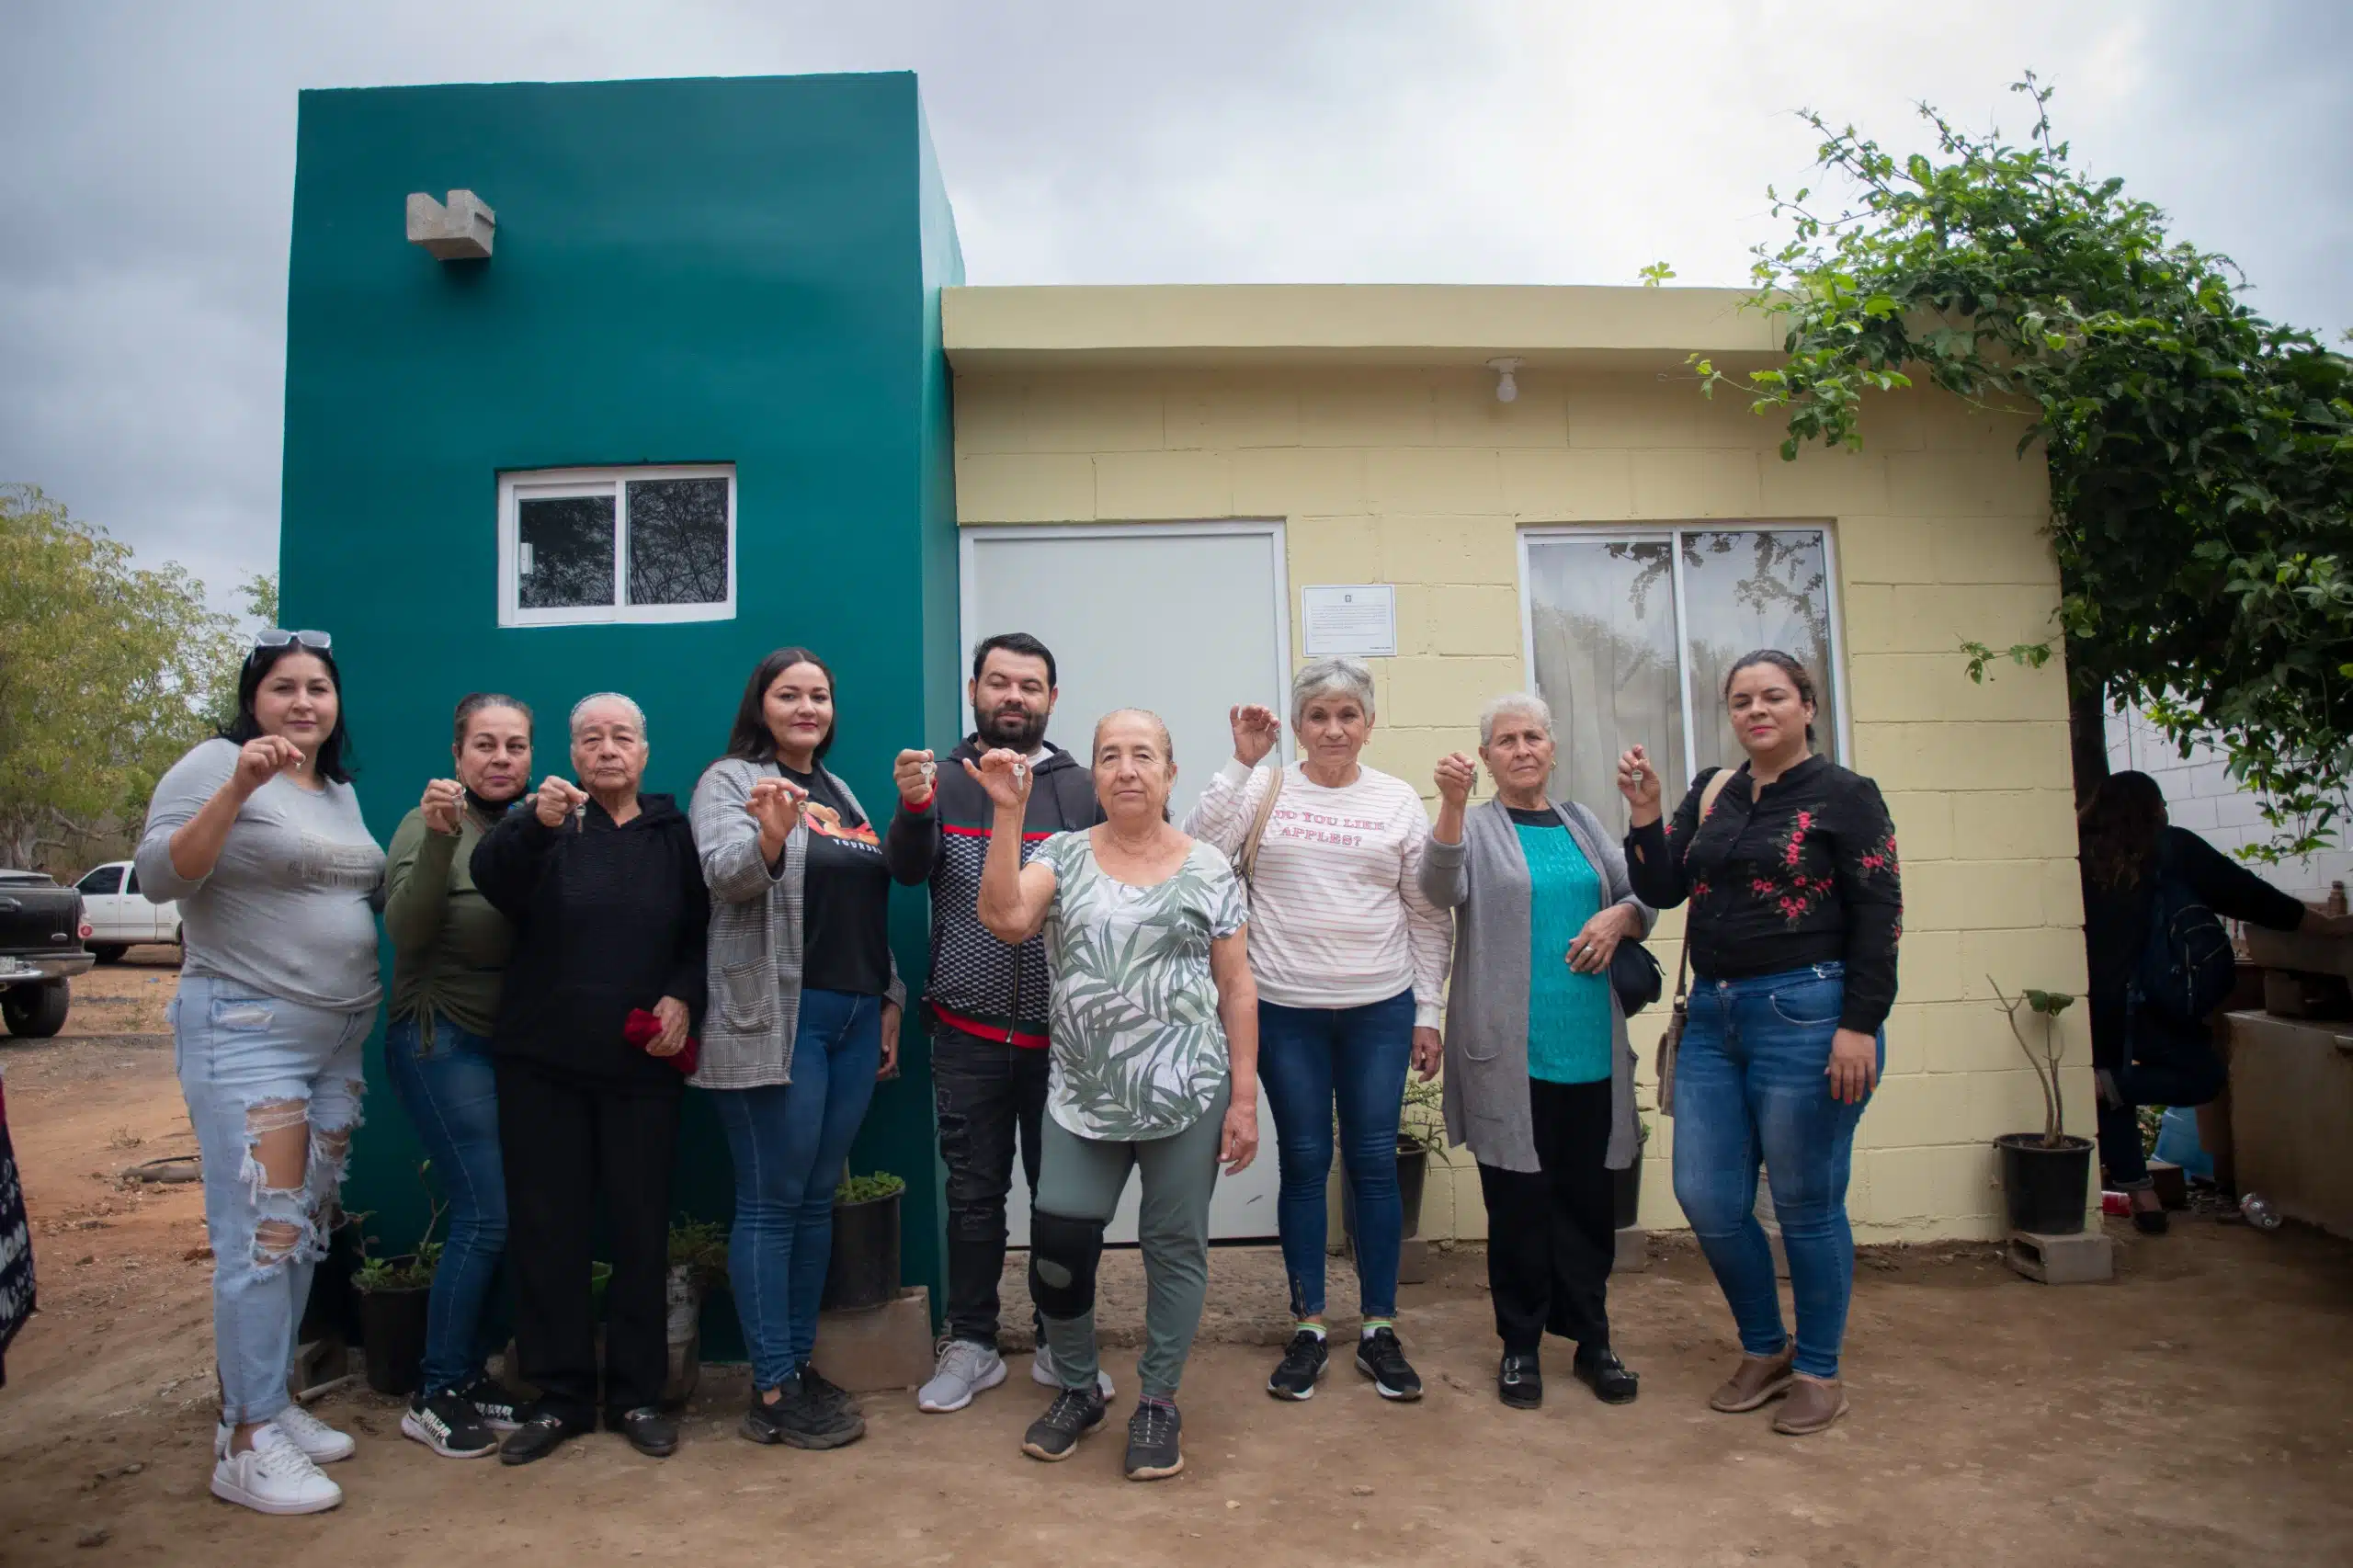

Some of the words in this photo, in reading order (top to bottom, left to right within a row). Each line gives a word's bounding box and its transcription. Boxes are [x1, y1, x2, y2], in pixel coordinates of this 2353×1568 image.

[1274, 810, 1297, 821] DO
[1302, 812, 1338, 826] YOU
[1344, 819, 1385, 831] LIKE
[1280, 826, 1362, 846] APPLES?
